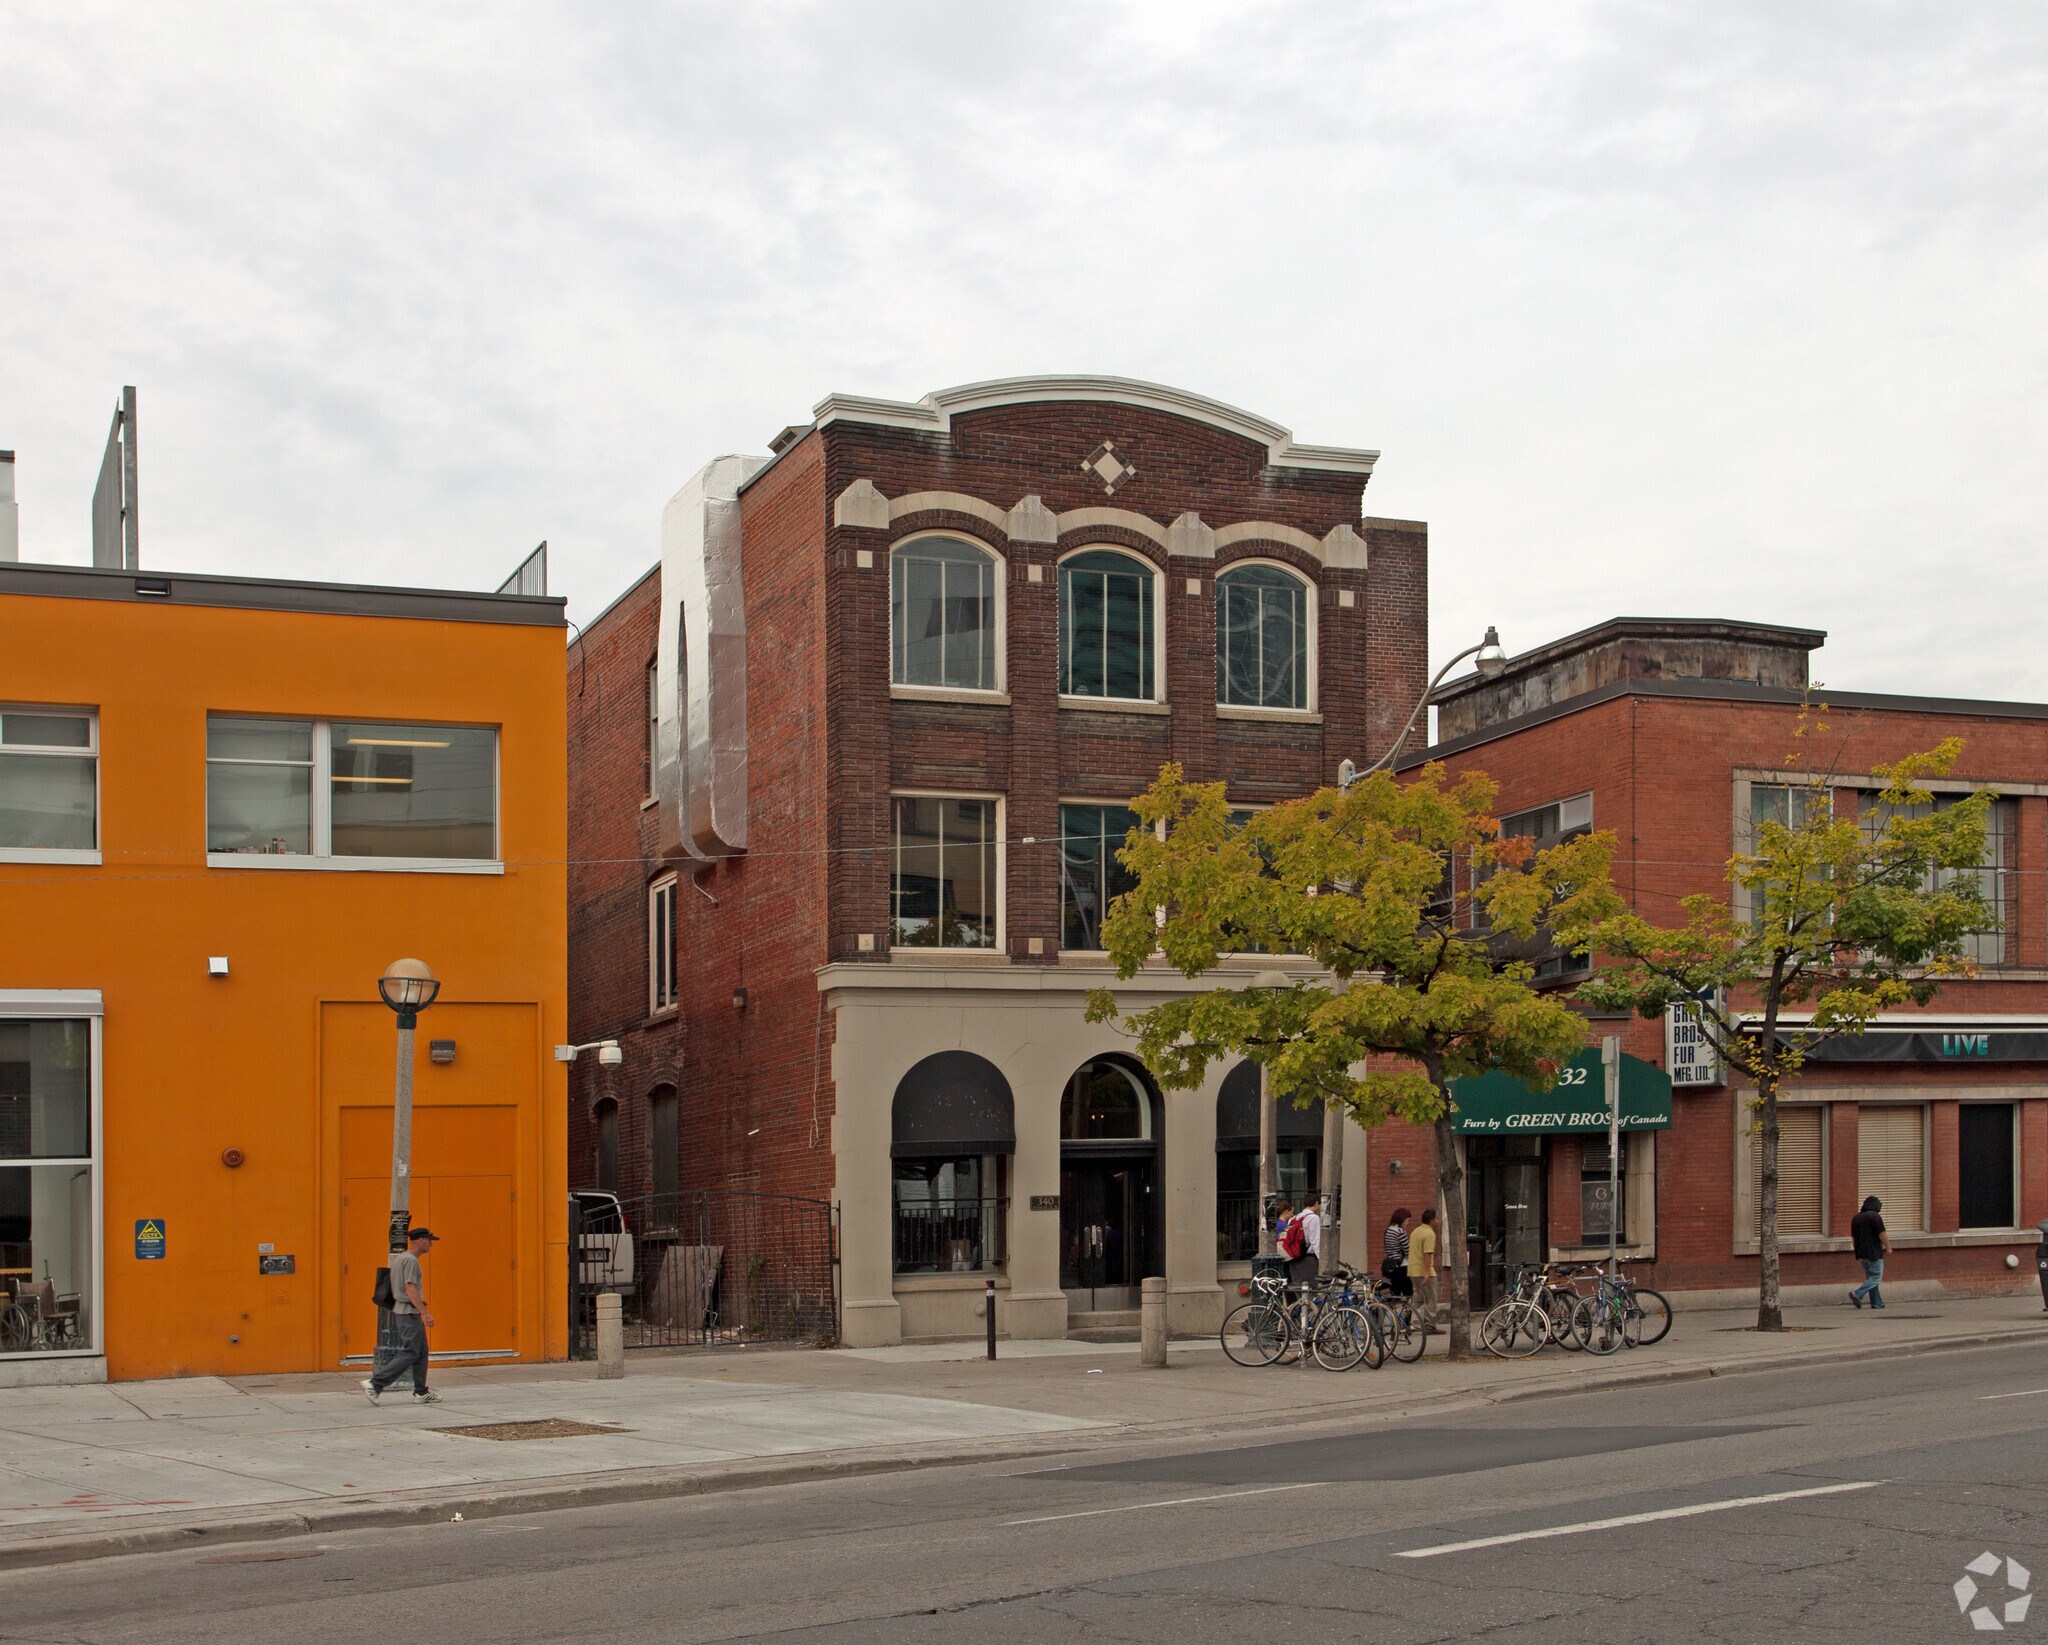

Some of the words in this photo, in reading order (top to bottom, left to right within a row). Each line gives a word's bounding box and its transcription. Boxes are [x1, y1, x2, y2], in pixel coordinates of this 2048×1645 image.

[1943, 1034, 1988, 1056] LIVE
[1674, 1046, 1695, 1064] FUR
[1555, 1067, 1588, 1086] 32
[1674, 1067, 1693, 1082] MFG.
[1695, 1066, 1710, 1081] LTD.
[1463, 1118, 1486, 1128] Furs
[1488, 1118, 1501, 1130] by
[1505, 1113, 1566, 1127] GREEN
[1617, 1116, 1629, 1127] of
[1630, 1113, 1668, 1125] Canada
[1038, 1197, 1054, 1206] 340
